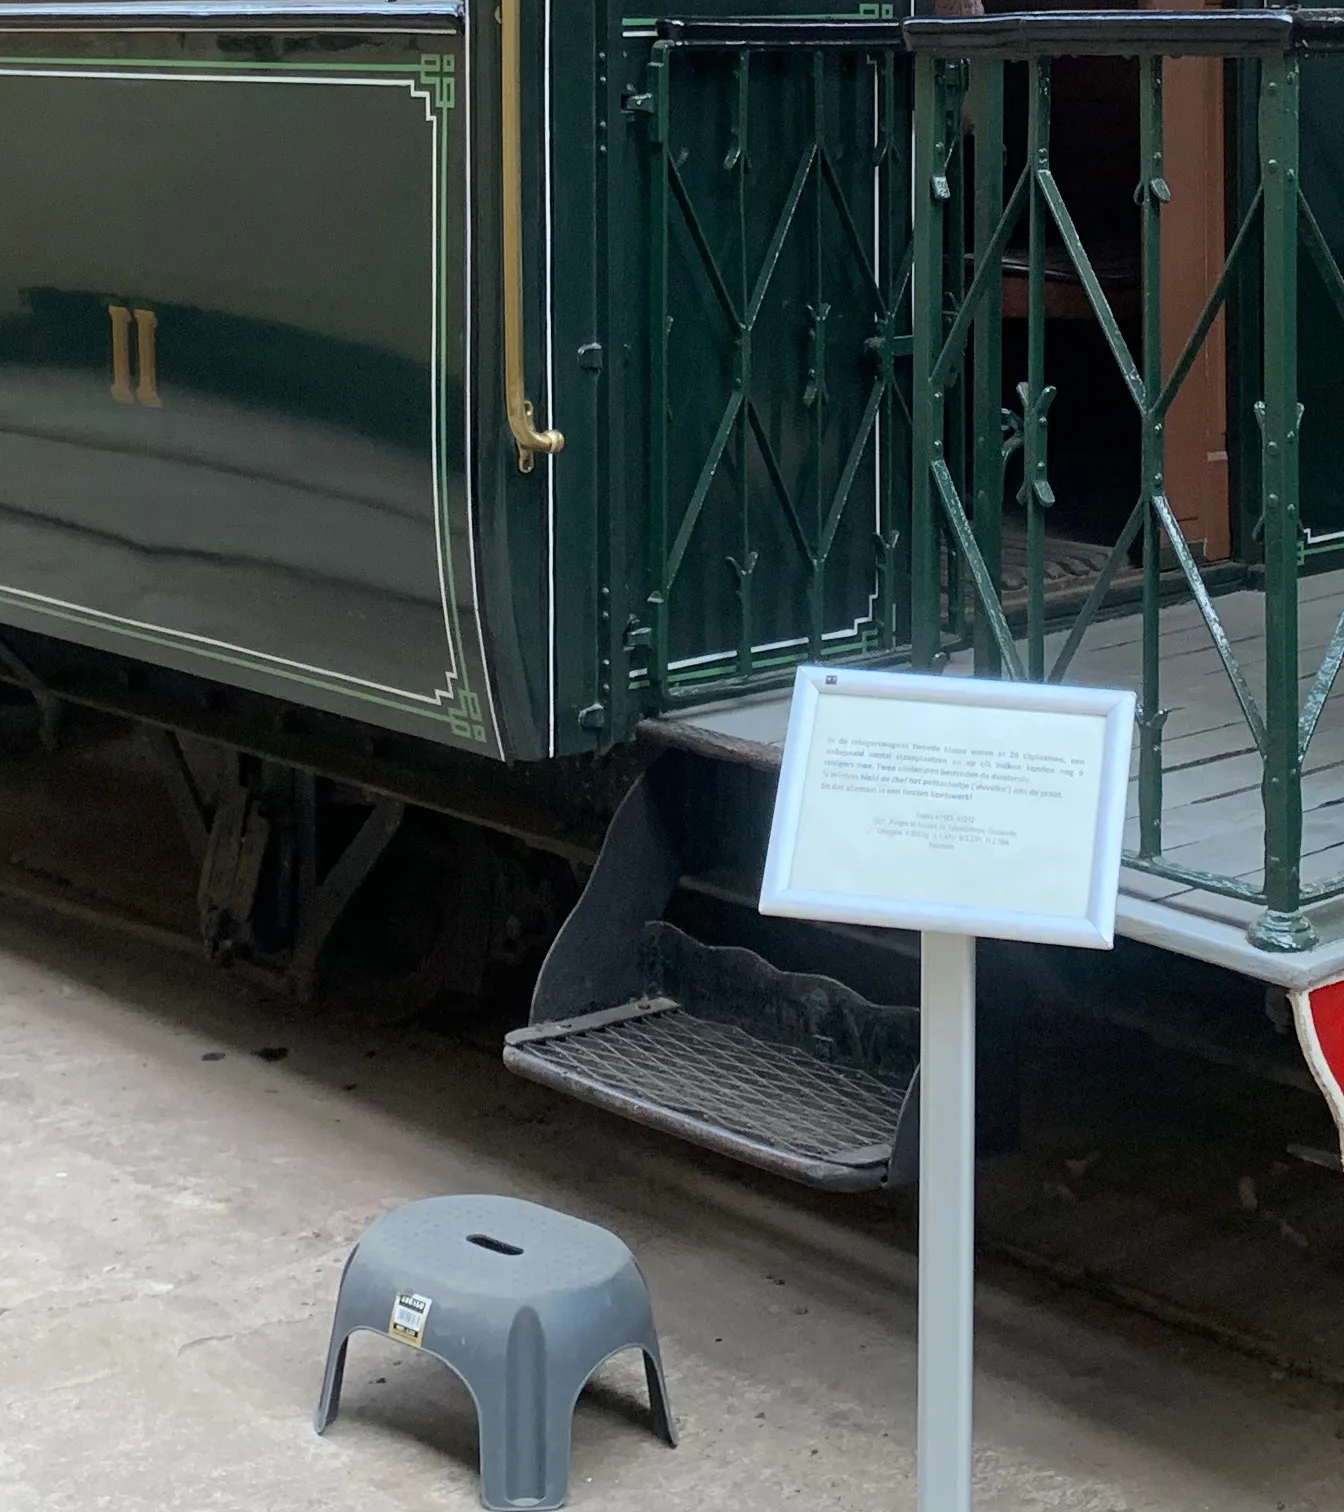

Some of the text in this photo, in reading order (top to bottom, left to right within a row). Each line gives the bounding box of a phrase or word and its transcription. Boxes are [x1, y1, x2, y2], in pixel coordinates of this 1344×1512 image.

[108, 305, 163, 408] II
[876, 763, 896, 772] Twee
[908, 776, 921, 784] het
